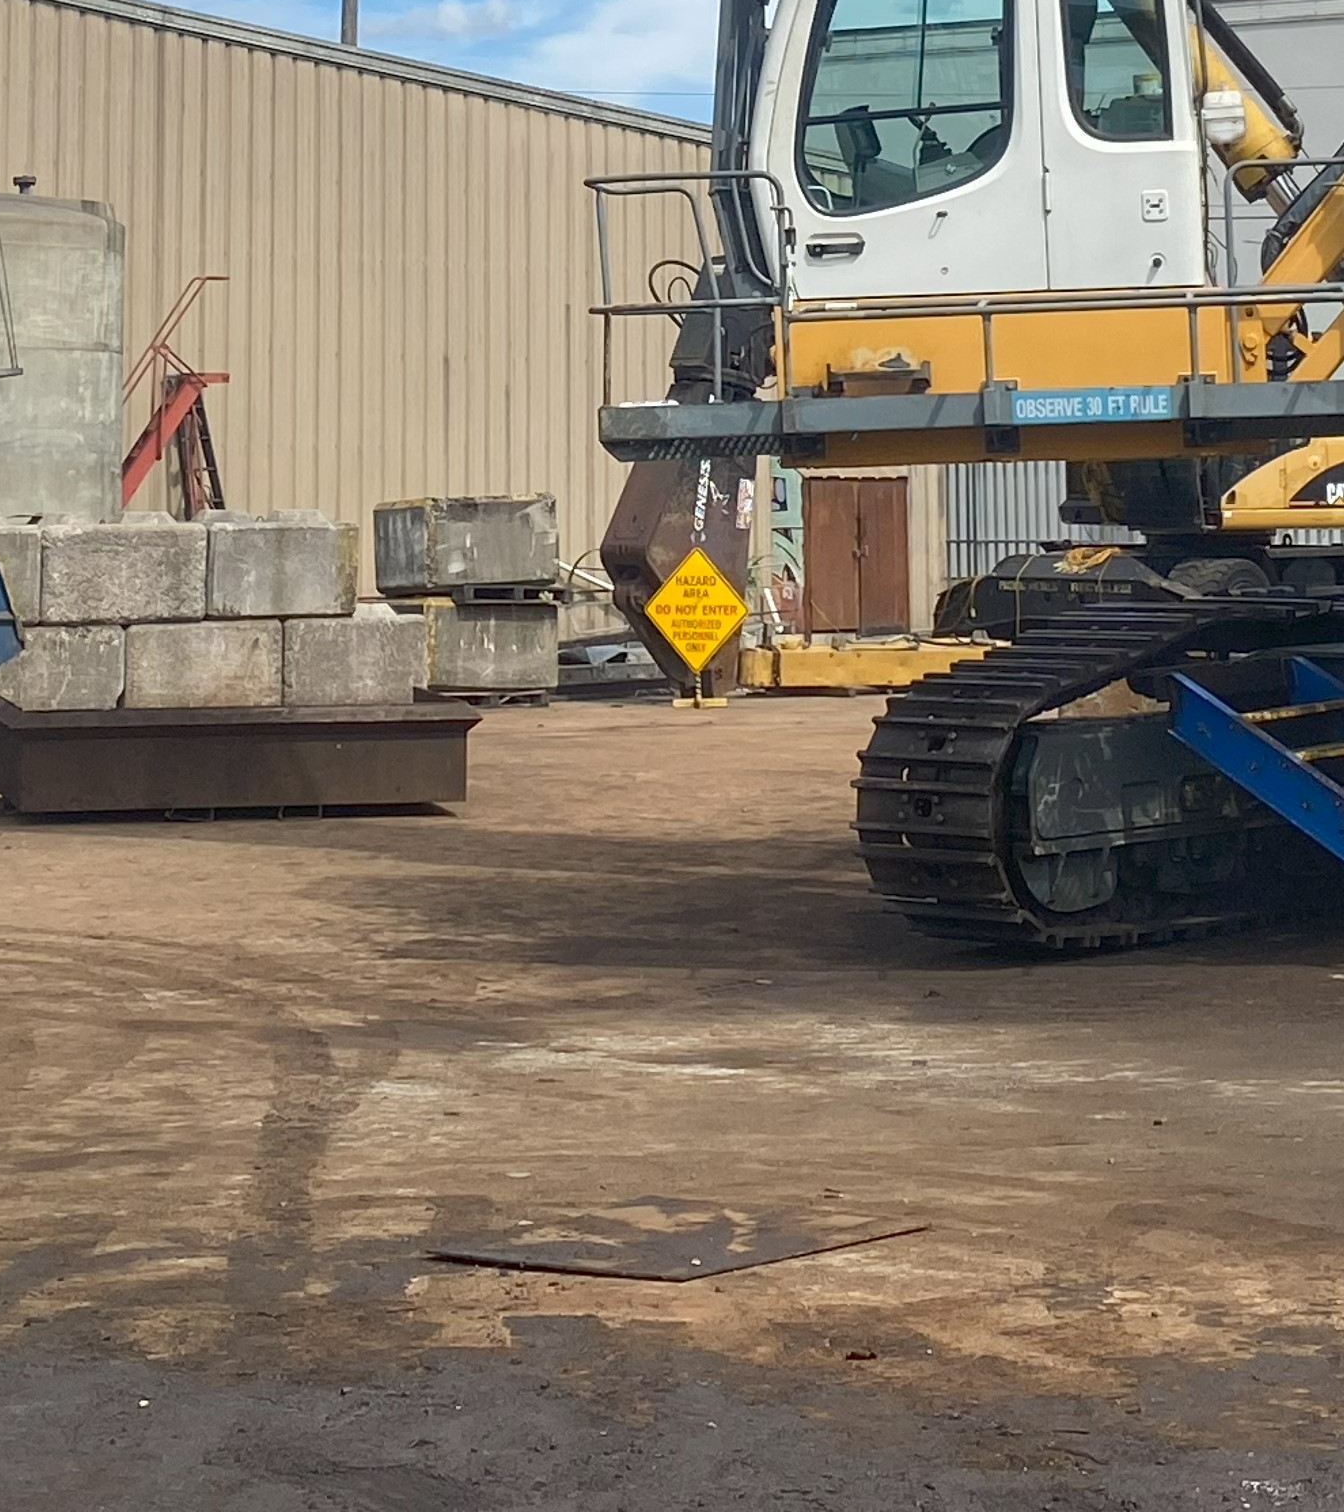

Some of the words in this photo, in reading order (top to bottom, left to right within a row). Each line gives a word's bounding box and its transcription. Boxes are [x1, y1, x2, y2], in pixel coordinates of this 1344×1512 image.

[1016, 397, 1083, 418] OBSERVE
[1086, 396, 1103, 416] 30
[1108, 395, 1125, 415] FT
[1129, 394, 1168, 414] RULE
[693, 459, 711, 531] GENESIS
[675, 575, 717, 586] HAZARD
[683, 588, 709, 598] AREA
[656, 605, 671, 615] DO
[676, 605, 697, 615] NOT
[702, 606, 738, 616] ENTER
[671, 619, 722, 629] AUTHORIZED
[685, 643, 706, 652] ONLY
